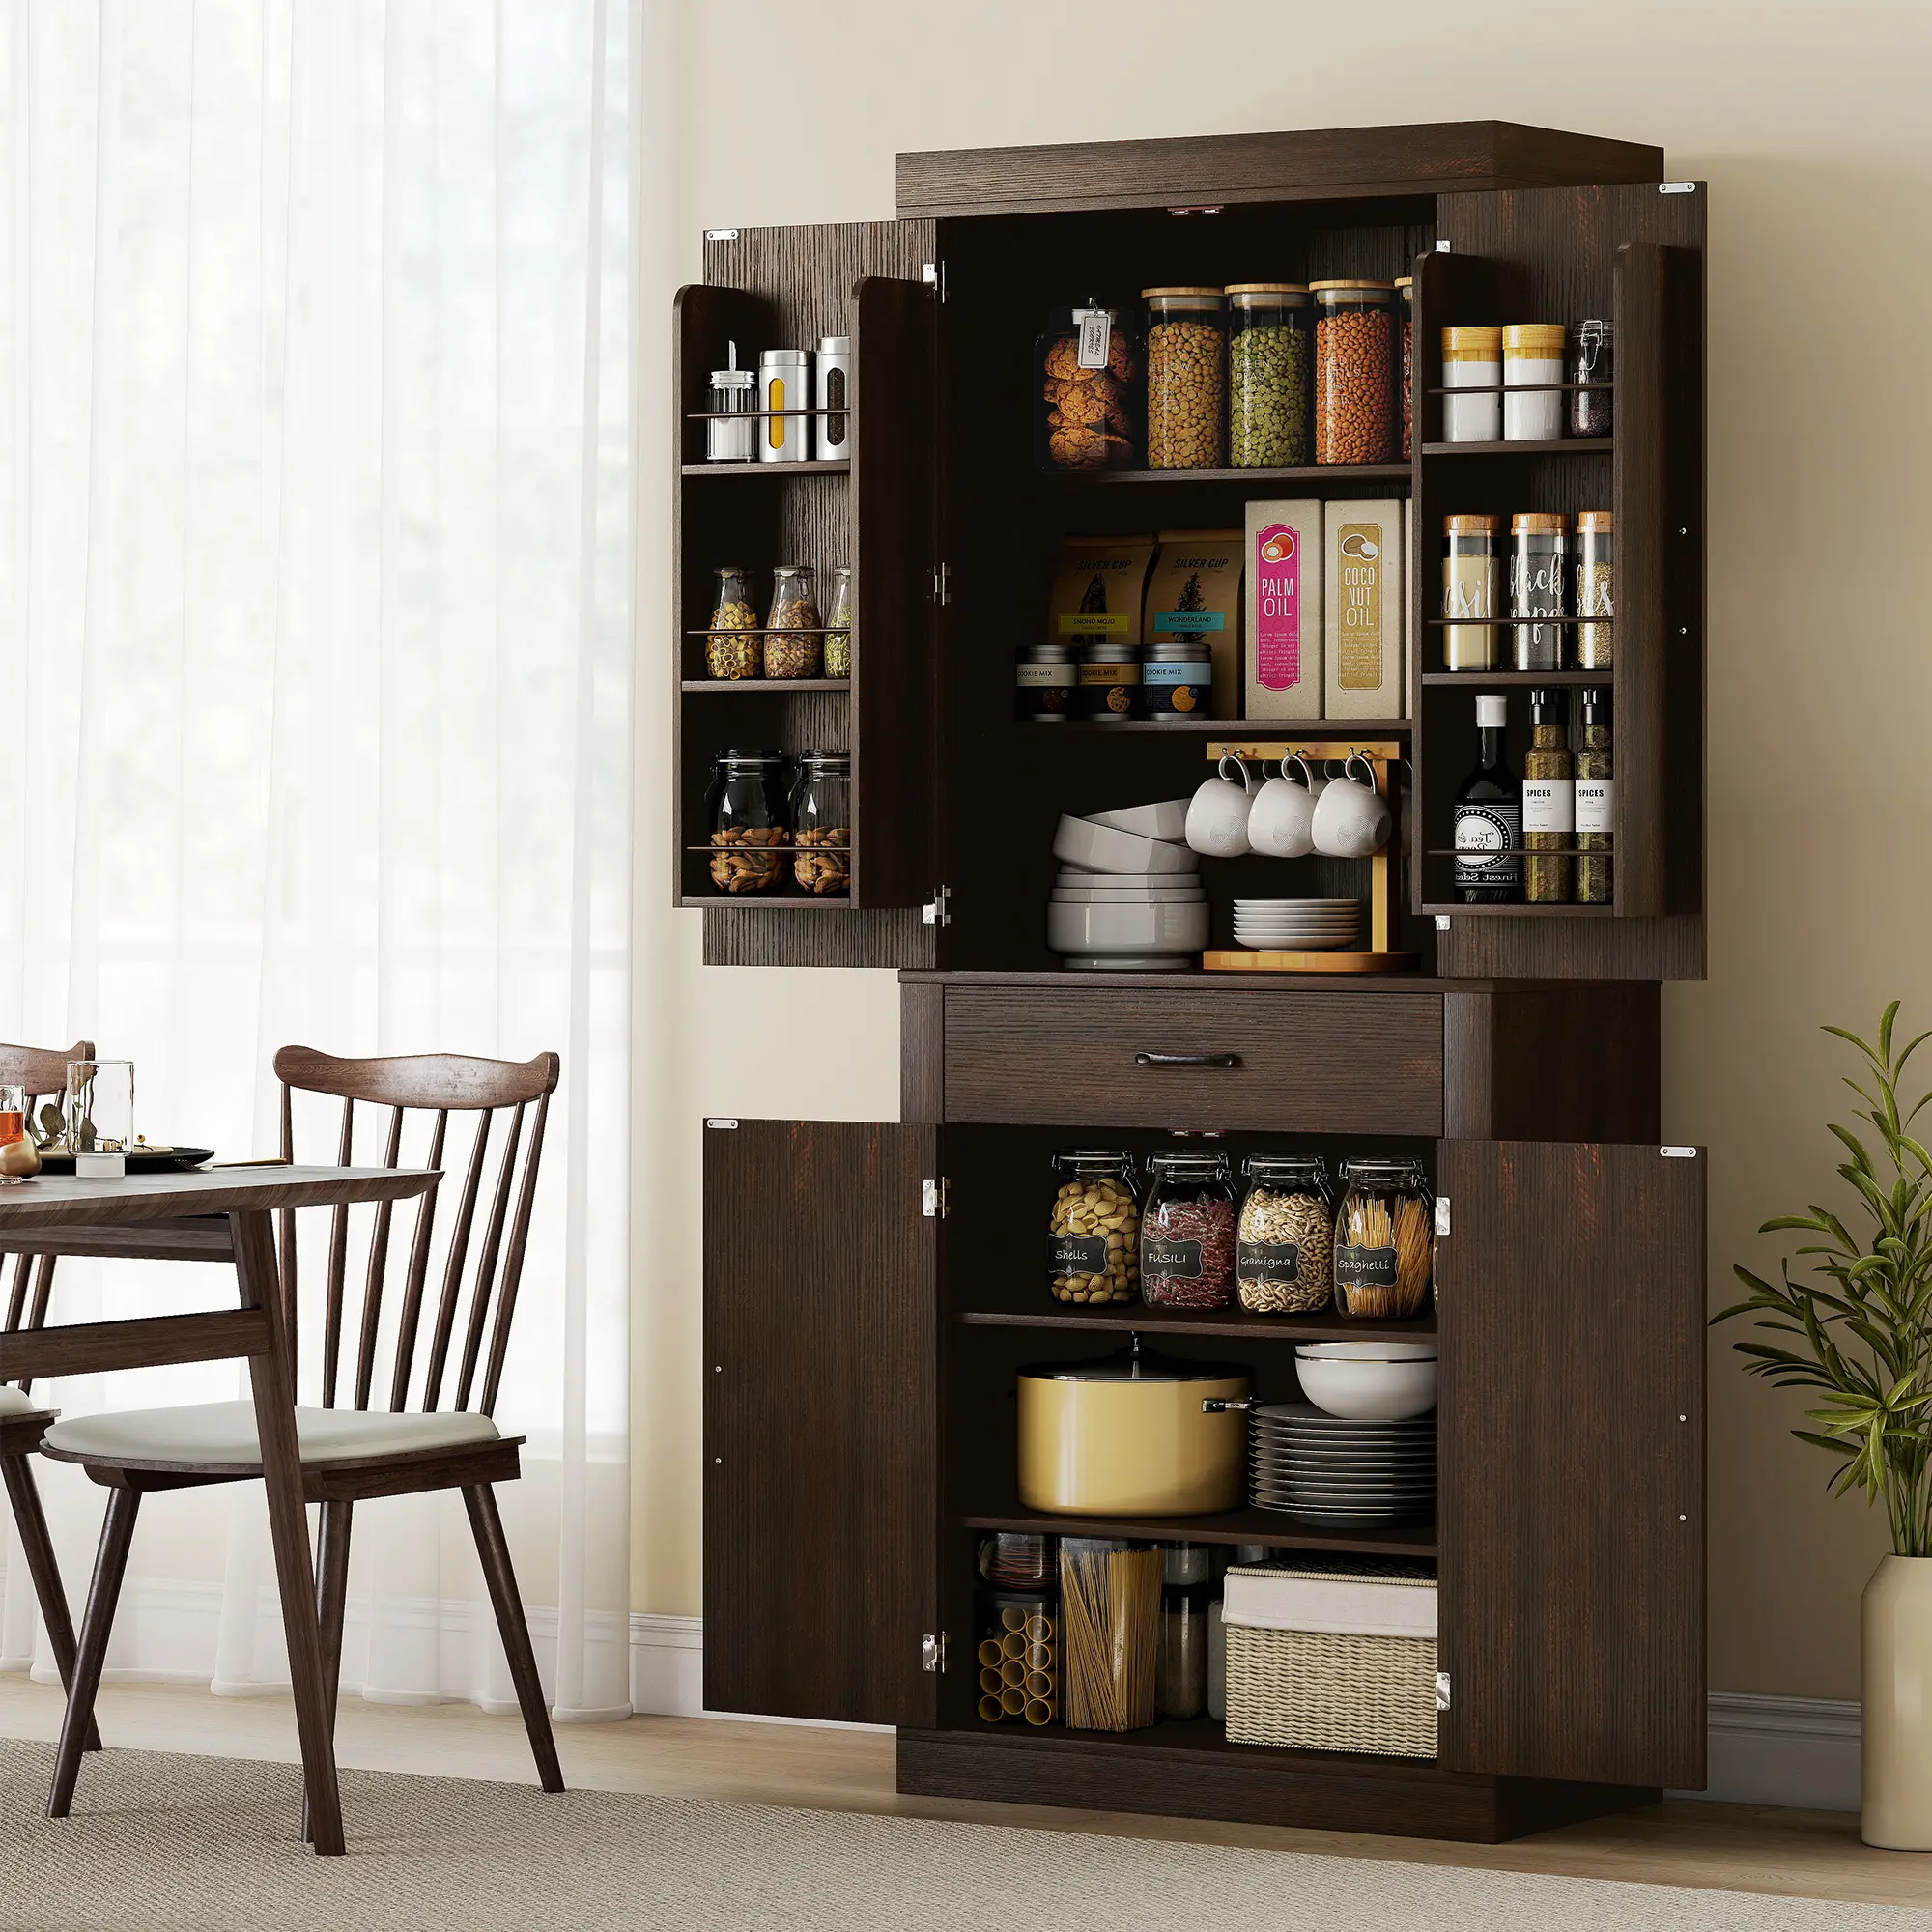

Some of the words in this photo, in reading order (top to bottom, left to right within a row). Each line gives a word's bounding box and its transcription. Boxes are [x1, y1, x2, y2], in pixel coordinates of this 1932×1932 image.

[1149, 361, 1191, 372] ELLOW
[1152, 375, 1181, 384] PEAS
[1236, 372, 1264, 382] PEAS
[1077, 560, 1109, 571] SILVER
[1111, 559, 1132, 570] CUP
[1174, 559, 1207, 569] SILVER
[1208, 558, 1229, 569] CUP
[1344, 567, 1375, 586] COCO
[1262, 578, 1293, 596] PALM
[1441, 559, 1496, 619] asil
[1349, 587, 1372, 606] NUT
[1264, 597, 1293, 617] OIL
[1346, 607, 1375, 627] OIL
[1526, 789, 1551, 798] SPICES
[1578, 789, 1605, 798] SPICES
[1054, 1249, 1089, 1261] Shells
[1240, 1256, 1292, 1270] Gramigna
[1338, 1258, 1390, 1273] Spaghetti
